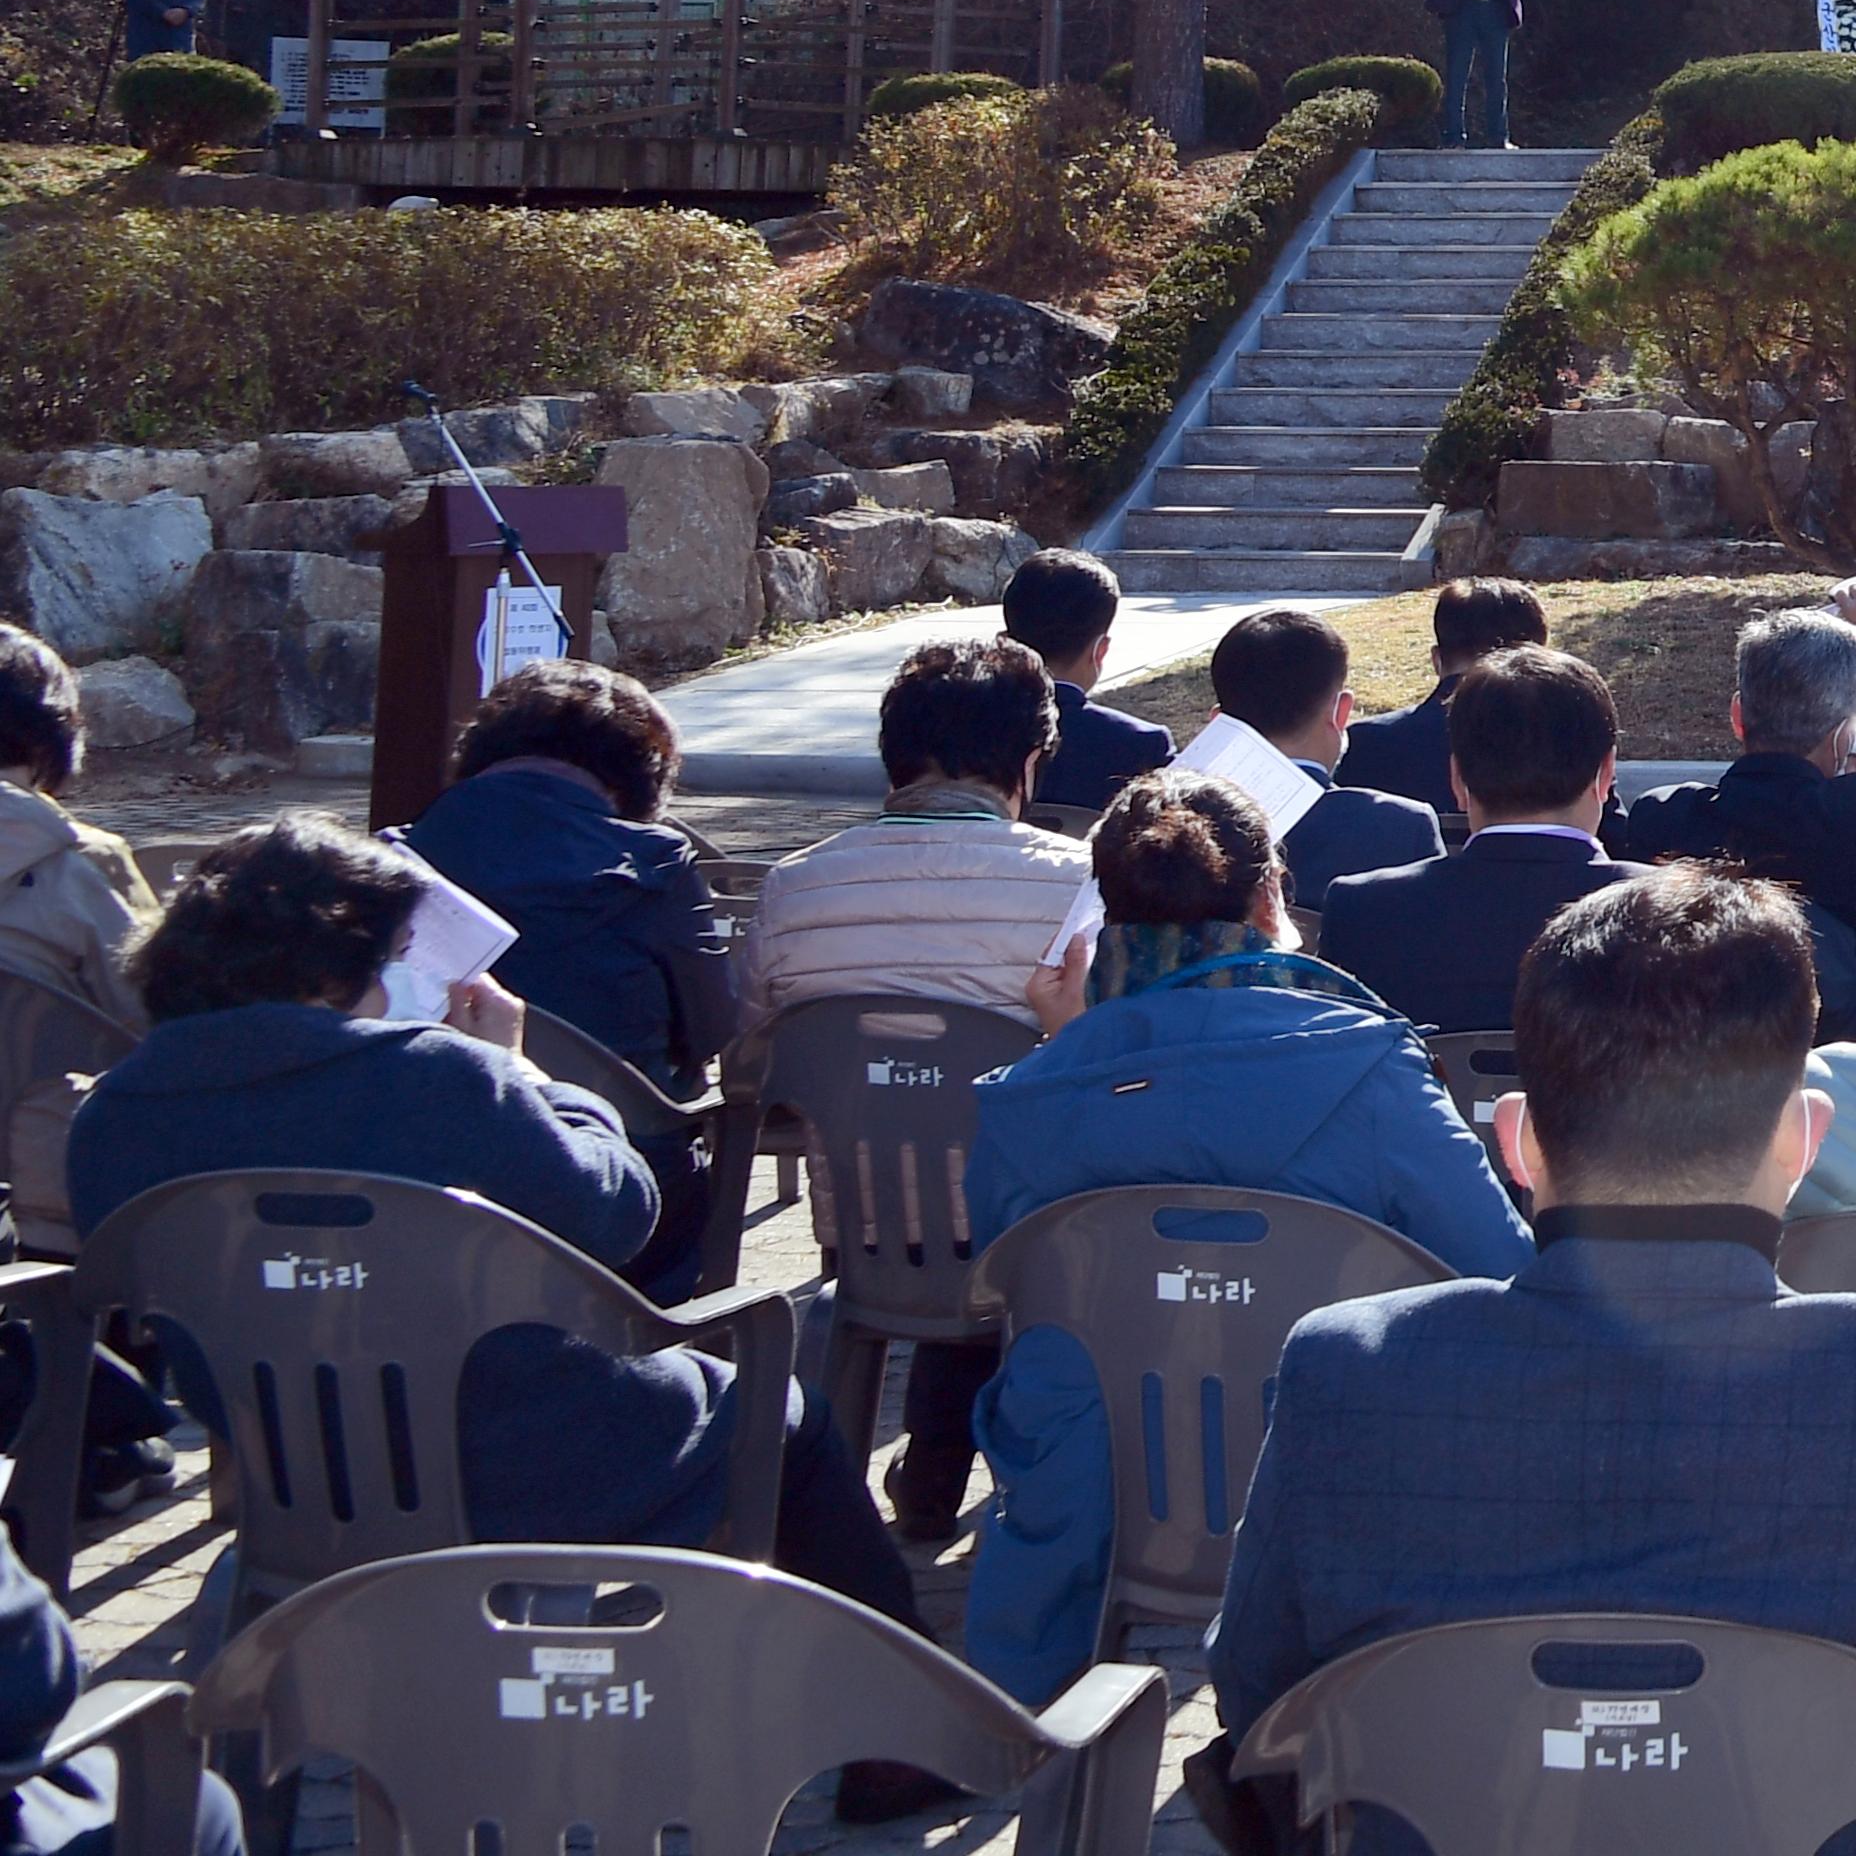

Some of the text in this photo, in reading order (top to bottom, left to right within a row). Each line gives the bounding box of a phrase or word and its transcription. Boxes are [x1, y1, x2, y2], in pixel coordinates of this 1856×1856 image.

[895, 1066, 944, 1087] 나라
[301, 1262, 369, 1290] 나라
[1192, 1277, 1256, 1305] 나라
[555, 1679, 655, 1720] 나라
[1595, 1732, 1689, 1771] 나라
